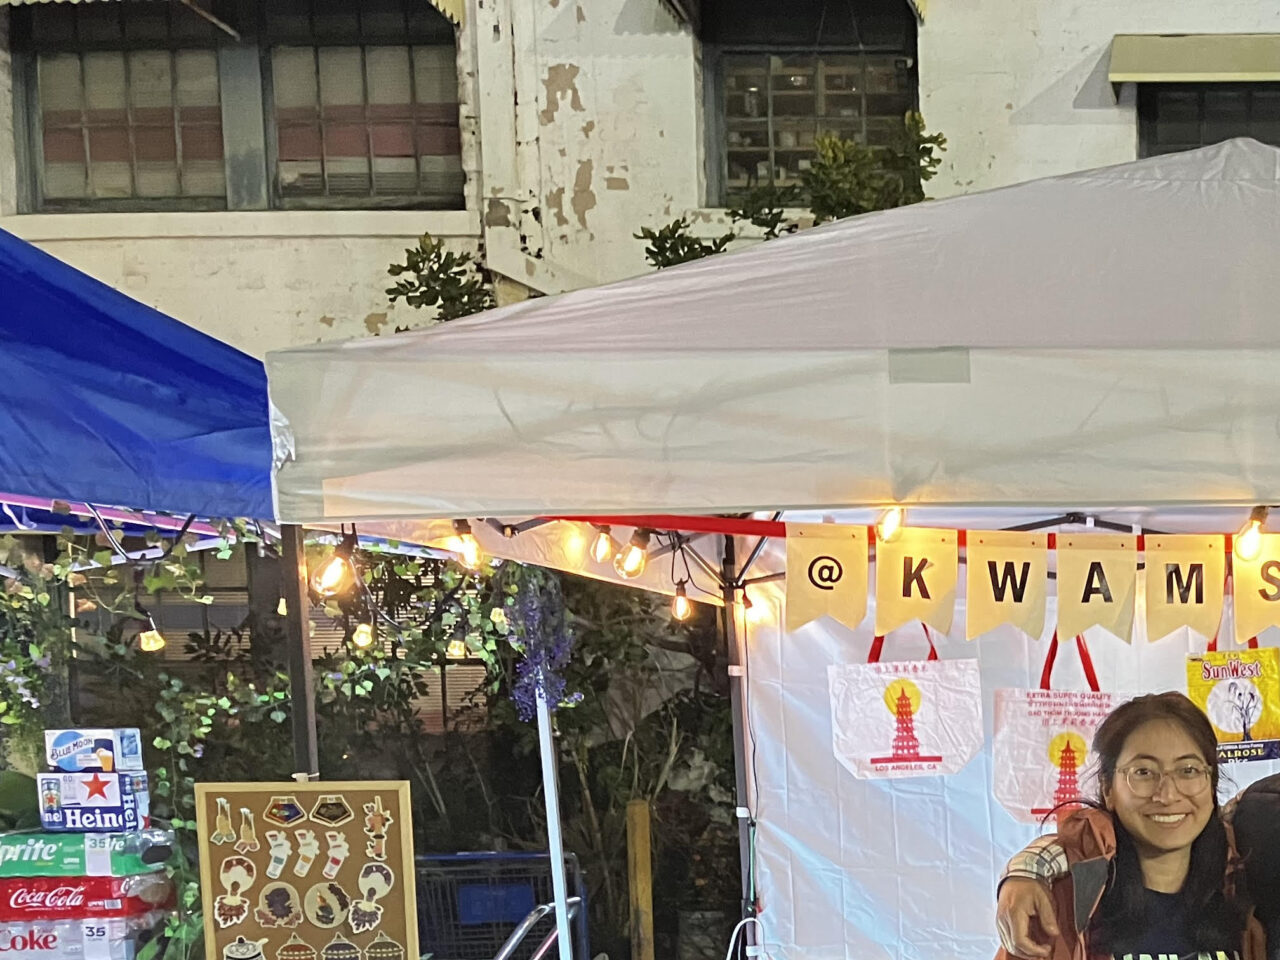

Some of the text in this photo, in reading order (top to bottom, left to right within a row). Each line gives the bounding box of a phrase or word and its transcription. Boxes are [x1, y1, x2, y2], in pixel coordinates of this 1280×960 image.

[1053, 692, 1078, 700] SUPER
[50, 747, 72, 760] BLUE
[71, 738, 93, 752] MOON
[85, 926, 106, 937] 35
